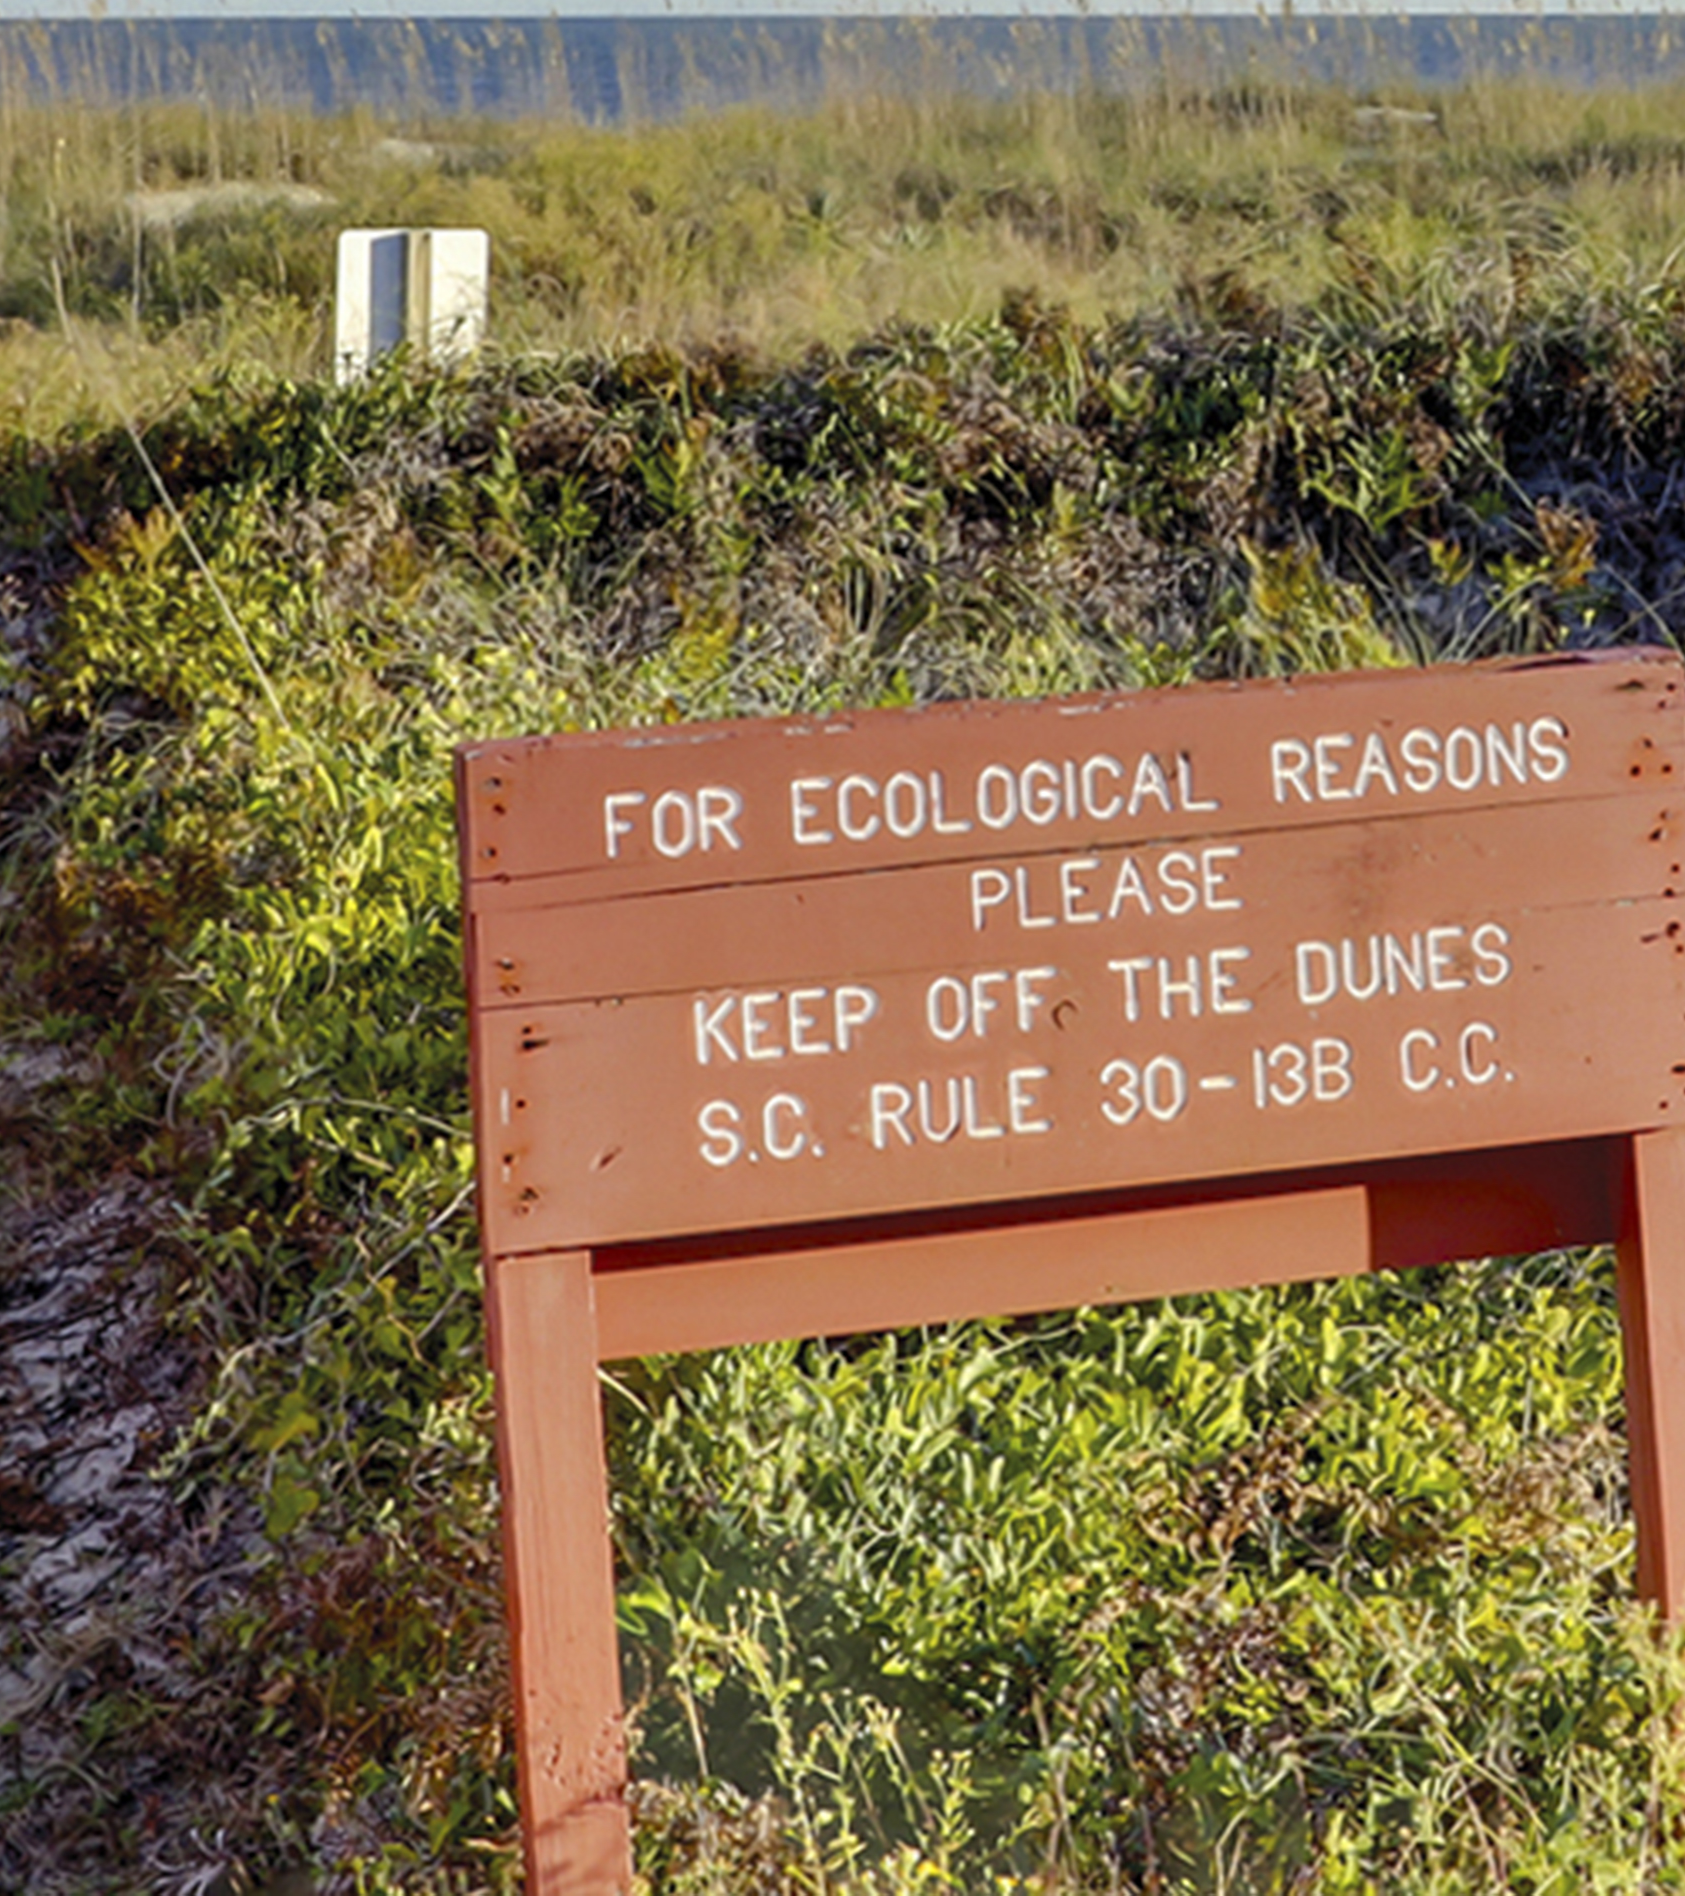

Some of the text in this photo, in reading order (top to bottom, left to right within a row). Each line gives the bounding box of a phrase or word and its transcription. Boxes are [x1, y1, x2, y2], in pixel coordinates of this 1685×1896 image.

[602, 716, 1569, 859] FOR ECOLOGICAL REASONS
[969, 845, 1244, 931] PLEASE
[692, 921, 1511, 1067] KEEP OFF THE DUNES
[696, 1020, 1516, 1168] S.C. RULE 30-13B C.C.
